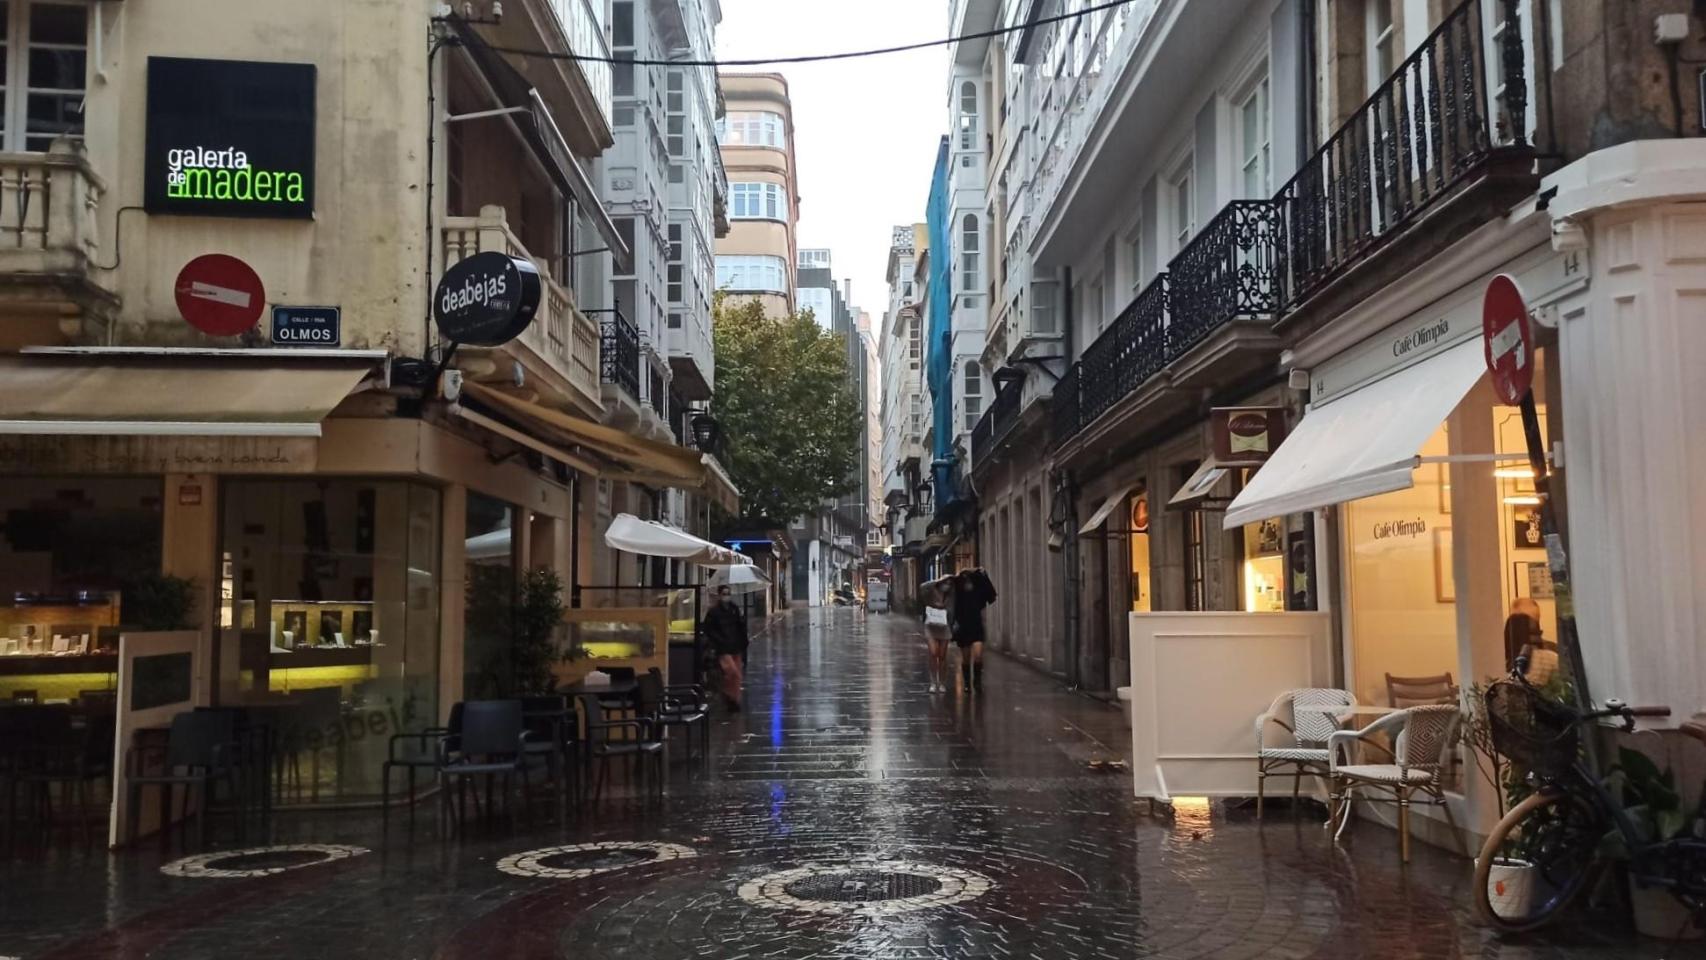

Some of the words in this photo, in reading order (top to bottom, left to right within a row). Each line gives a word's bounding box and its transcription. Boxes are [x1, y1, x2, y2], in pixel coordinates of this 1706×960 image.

[168, 146, 247, 171] galería
[168, 171, 186, 185] de
[184, 163, 304, 202] madera
[1564, 250, 1580, 277] 14
[442, 273, 507, 314] deabejas
[280, 328, 331, 341] OLMOS
[1393, 336, 1412, 357] Café
[1412, 319, 1449, 348] Olimpia
[1373, 521, 1392, 540] Café
[1392, 516, 1426, 539] Olimpia
